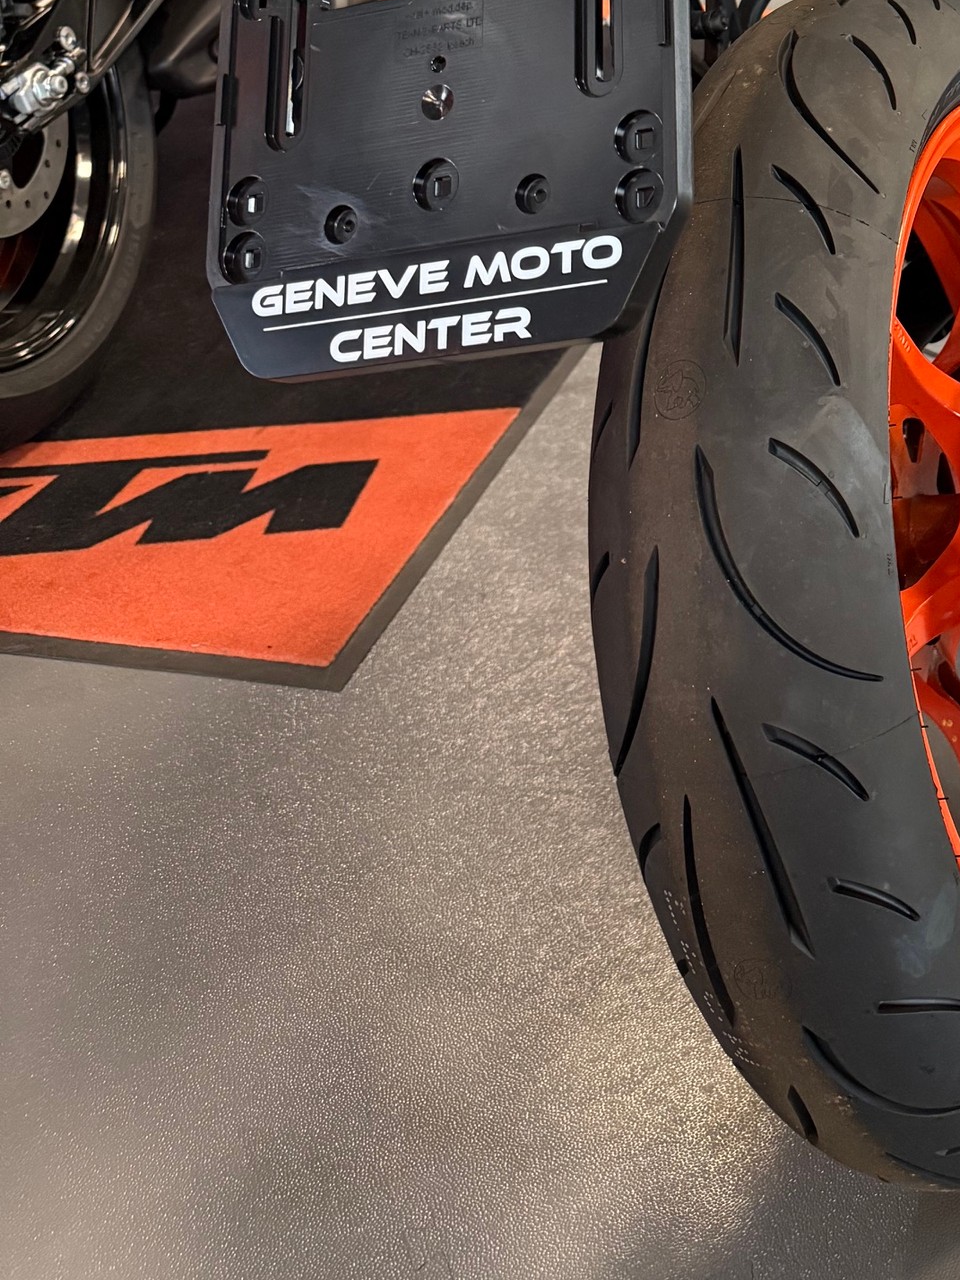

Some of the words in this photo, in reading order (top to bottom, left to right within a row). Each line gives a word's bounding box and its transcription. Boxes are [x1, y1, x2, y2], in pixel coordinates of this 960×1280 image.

[252, 260, 449, 317] GENEVE
[464, 235, 623, 288] MOTO
[330, 307, 531, 362] CENTER
[0, 450, 379, 556] TM
